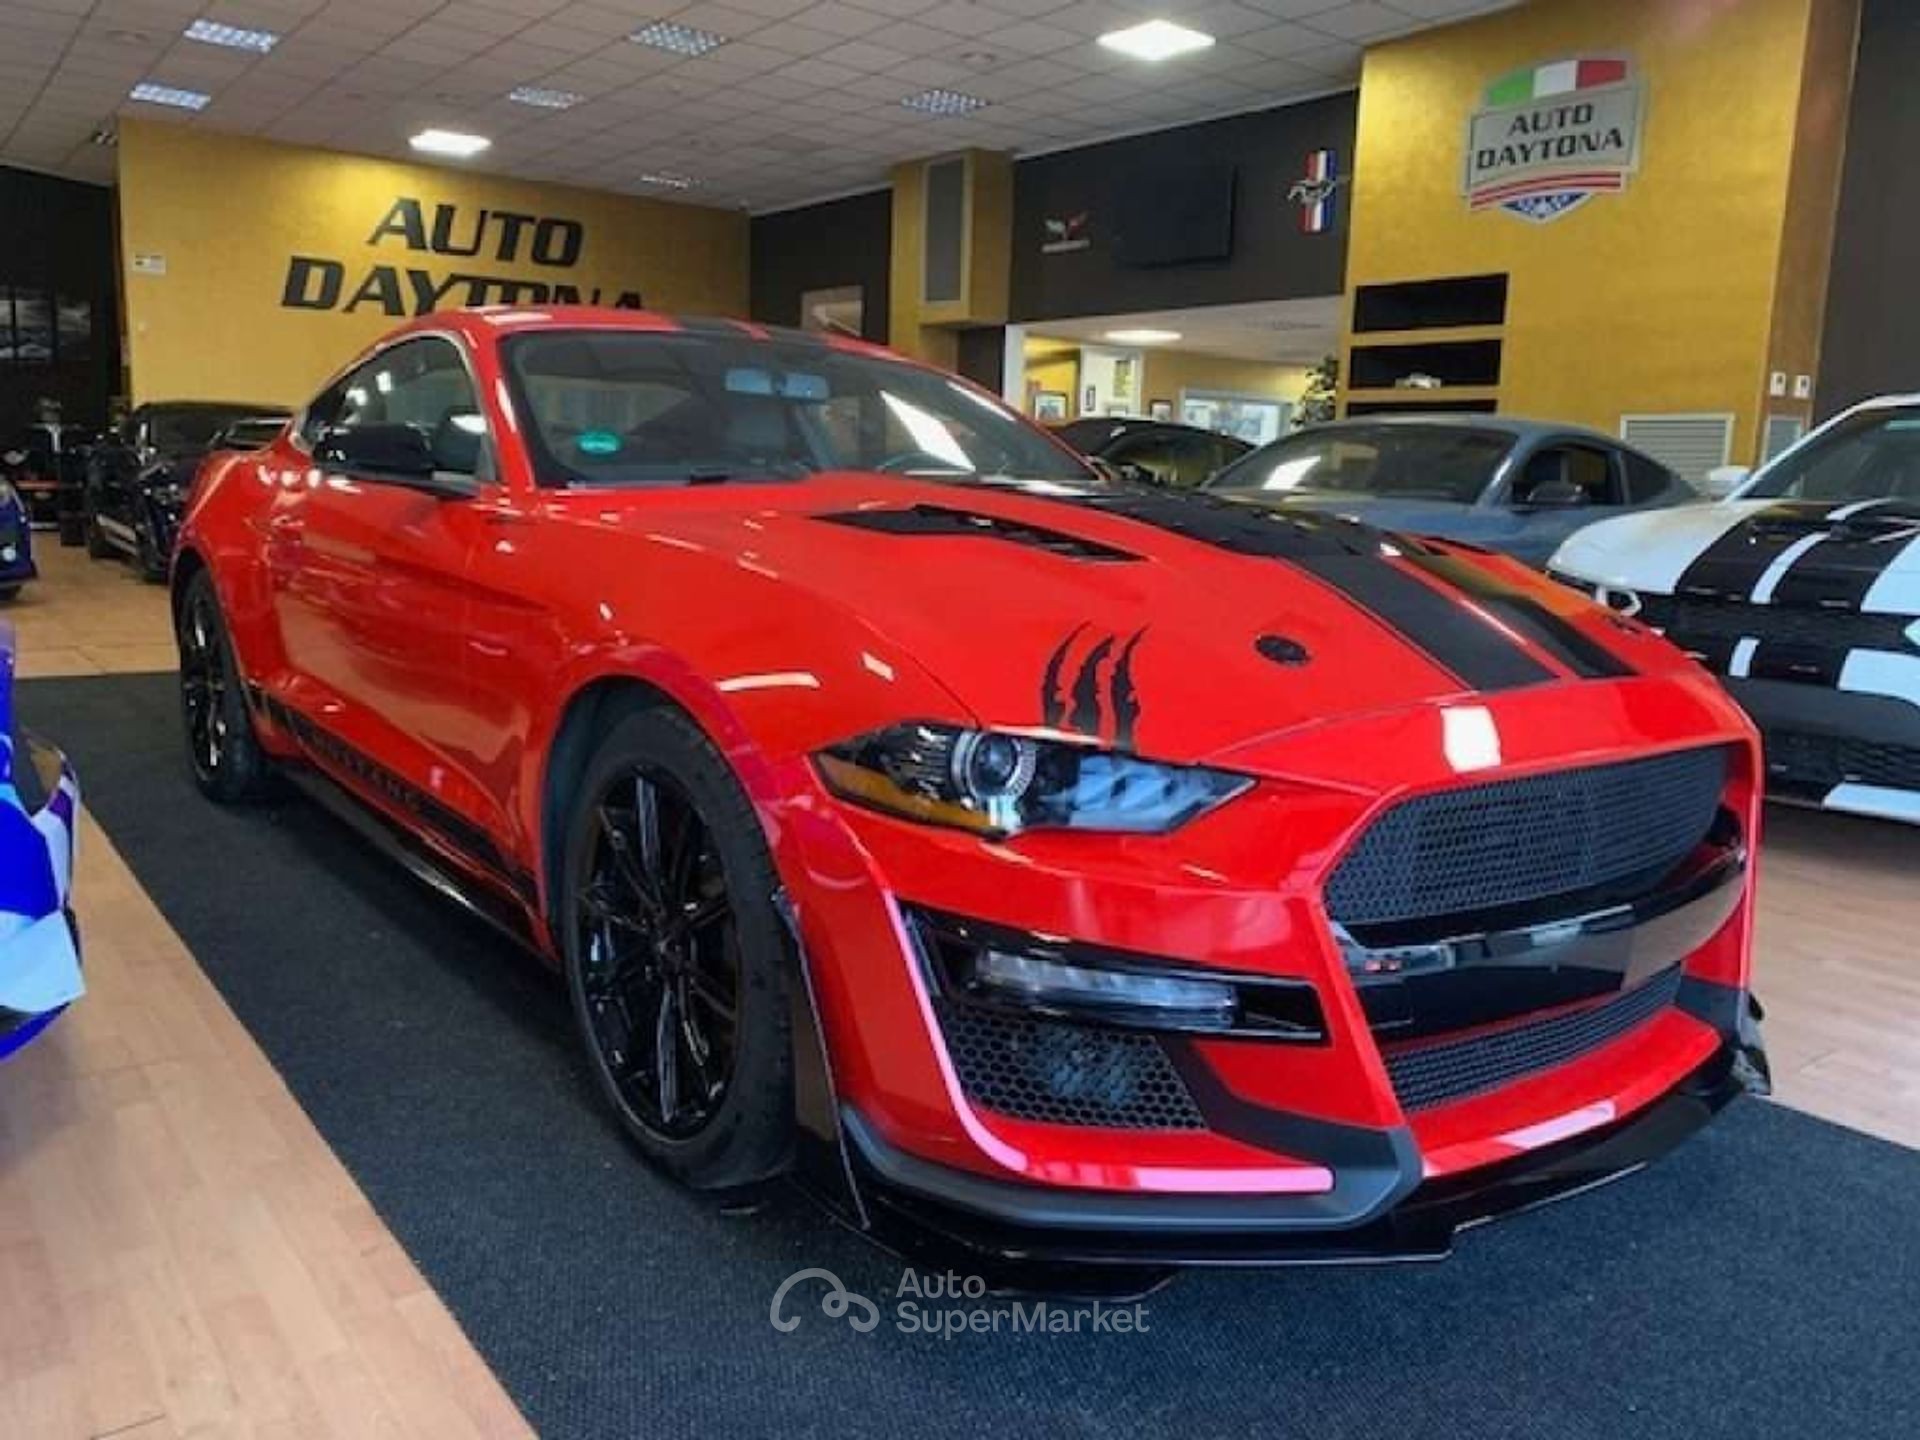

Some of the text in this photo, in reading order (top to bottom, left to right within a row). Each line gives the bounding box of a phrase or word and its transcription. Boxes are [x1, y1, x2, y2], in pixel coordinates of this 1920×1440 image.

[1509, 103, 1593, 136] AUTO
[1477, 128, 1623, 170] DAYTONA
[367, 197, 583, 267] AUTO
